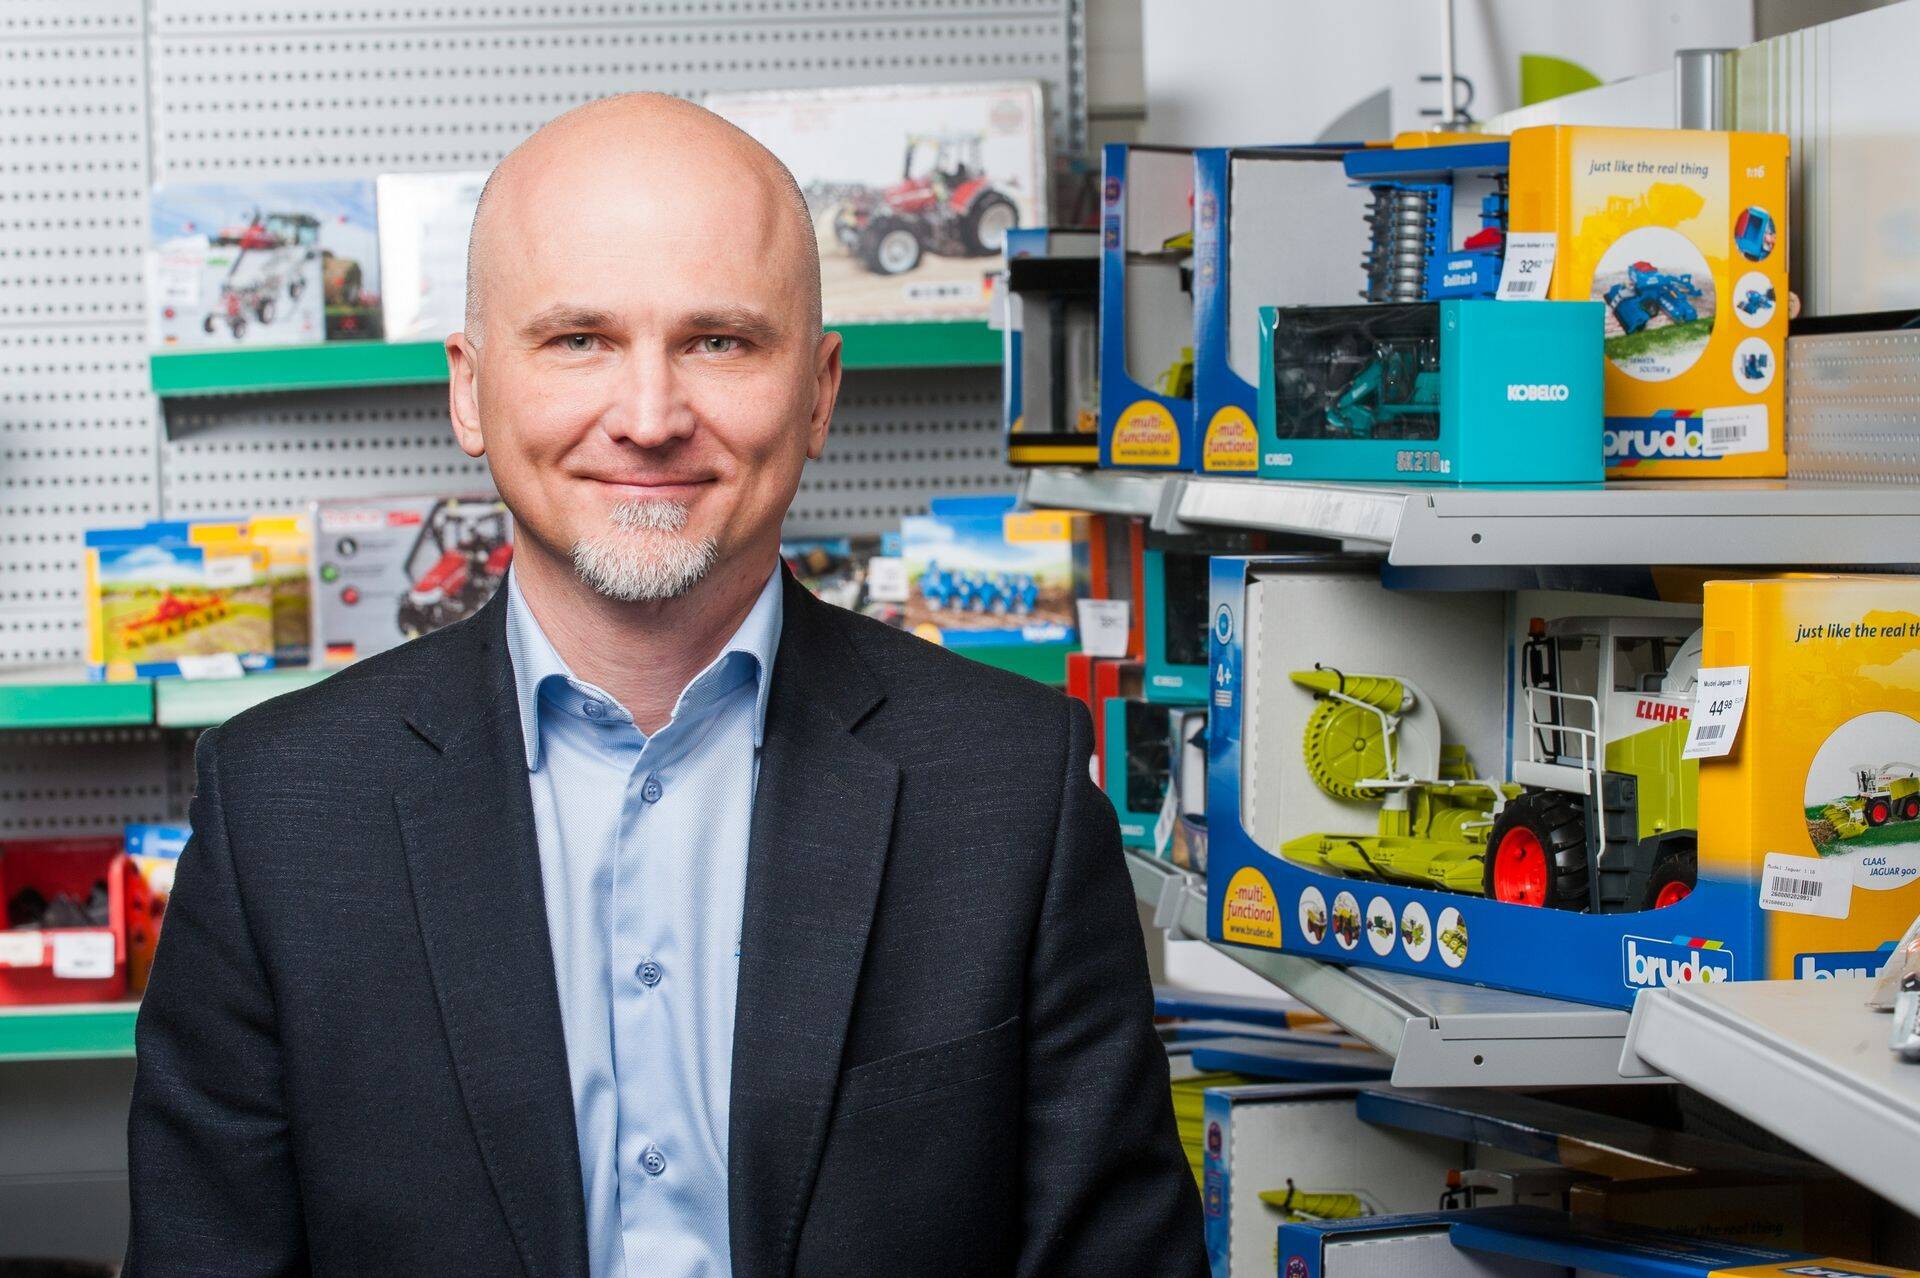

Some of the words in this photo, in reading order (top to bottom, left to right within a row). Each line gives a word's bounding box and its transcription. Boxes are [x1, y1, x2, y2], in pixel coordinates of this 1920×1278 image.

[1589, 160, 1611, 175] just
[1614, 160, 1633, 173] like
[1637, 161, 1654, 174] the
[1657, 162, 1678, 175] real
[1681, 163, 1709, 179] thing
[1507, 384, 1569, 401] KOBELCO
[1795, 623, 1823, 643] just
[1827, 623, 1851, 638] like
[1855, 622, 1877, 638] the
[1880, 622, 1906, 637] real
[1216, 663, 1232, 687] 4+
[1863, 856, 1886, 866] CLAAS
[1869, 867, 1900, 876] JAGUAR
[1901, 867, 1917, 877] 900
[1226, 900, 1276, 923] functional
[1230, 925, 1274, 939] www.bruder.de
[1627, 941, 1727, 987] bruder
